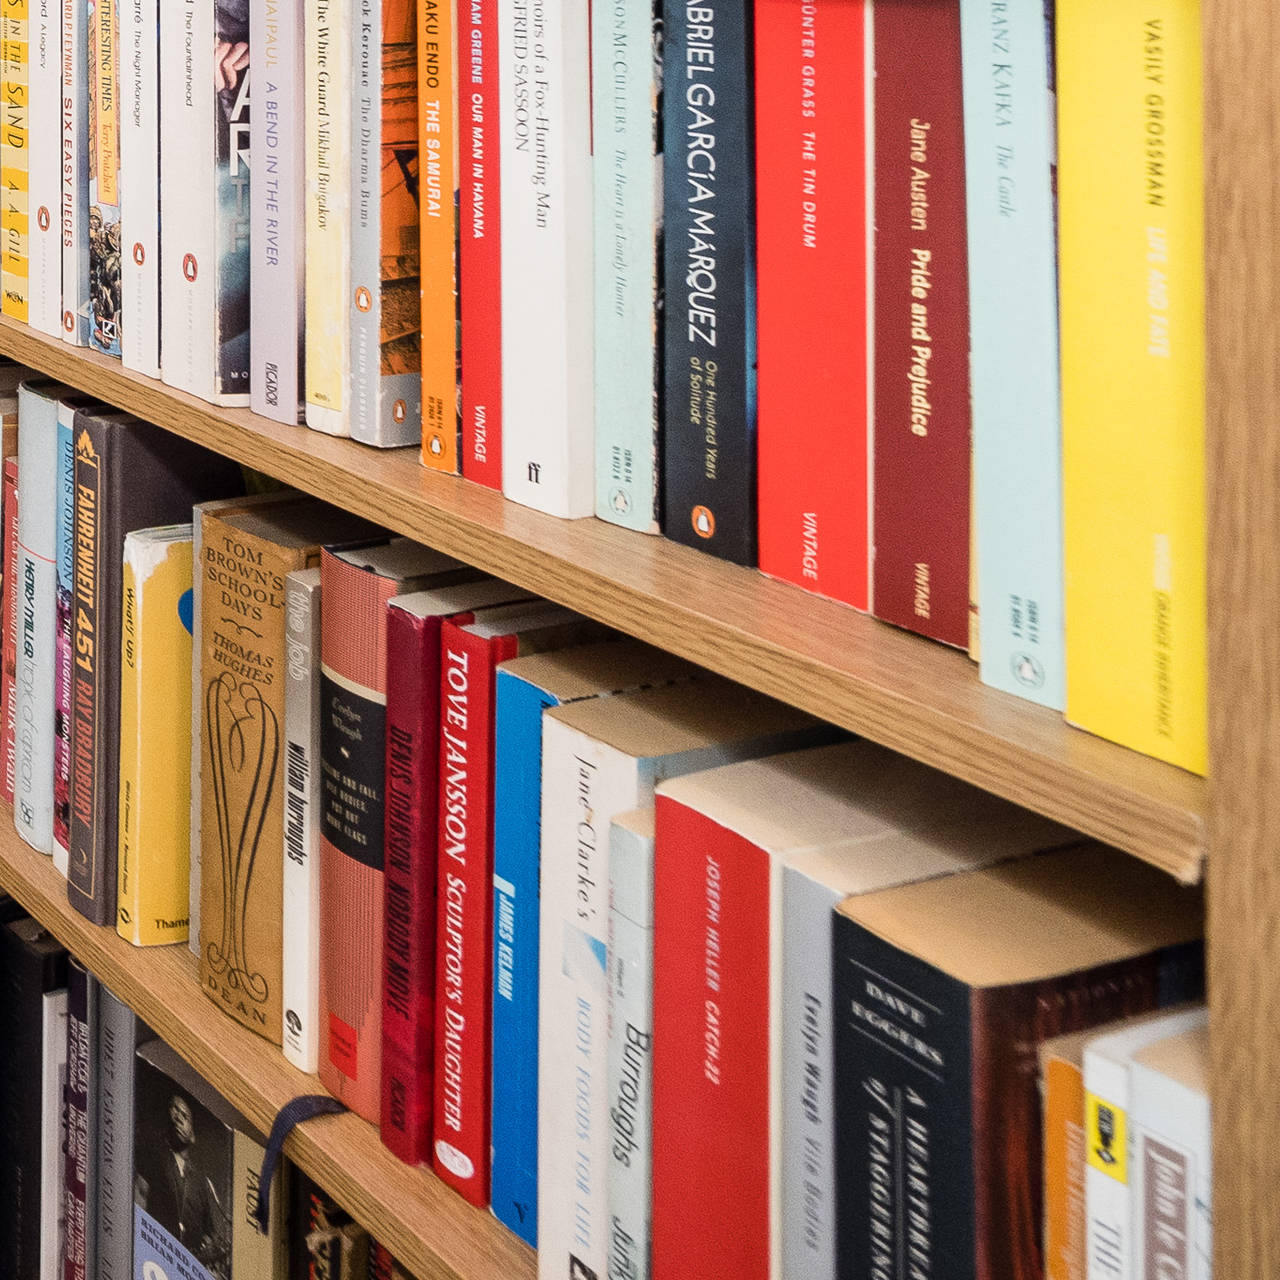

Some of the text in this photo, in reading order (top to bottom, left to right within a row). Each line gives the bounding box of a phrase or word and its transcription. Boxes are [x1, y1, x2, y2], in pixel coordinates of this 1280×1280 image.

[10, 20, 21, 36] IN
[64, 22, 73, 33] P.
[134, 30, 142, 46] The
[317, 27, 330, 68] White
[534, 41, 547, 61] of
[10, 44, 21, 72] THE
[64, 34, 73, 86] FEYNMAN
[133, 50, 142, 77] Night
[185, 31, 193, 107] Fountainhead
[361, 22, 372, 88] Kerouac
[426, 41, 439, 89] ENDO
[470, 29, 483, 84] GREENE
[536, 65, 546, 75] a
[101, 76, 112, 112] TIMES
[132, 79, 142, 128] Manager
[266, 82, 278, 94] A
[317, 71, 330, 117] Guard
[361, 97, 371, 122] The
[471, 92, 483, 122] OUR
[514, 64, 529, 152] SASSOON
[802, 64, 816, 118] GRASS
[991, 63, 1012, 128] KAFKA
[7, 82, 24, 149] SAND
[64, 97, 73, 131] SIX
[266, 100, 278, 149] BEND
[426, 100, 440, 132] THE
[532, 80, 551, 187] Fox-Hunting
[1144, 19, 1165, 208] VASILY GROSSMAN
[64, 138, 73, 186] EASY
[266, 154, 278, 175] IN
[317, 118, 330, 171] Mikhail
[360, 128, 371, 185] Dharma
[471, 123, 484, 159] MAN
[686, 85, 715, 204] GARCÍA
[802, 131, 816, 161] THE
[996, 145, 1016, 171] The
[8, 180, 21, 195] A.
[426, 138, 441, 218] SAMURAI
[472, 164, 484, 178] IN
[802, 167, 816, 195] TIN
[8, 204, 21, 218] A.
[266, 179, 278, 212] THE
[317, 173, 329, 231] Bulgakov
[473, 182, 485, 239] HAVANA
[535, 193, 548, 230] Man
[998, 175, 1017, 219] Castle
[64, 193, 73, 248] PIECES
[265, 218, 279, 267] RIVER
[802, 201, 817, 249] DRUM
[8, 228, 21, 262] GILL
[686, 208, 717, 347] MÁRQUEZ
[910, 118, 932, 437] Jane Austen Pride and Prejudice
[265, 361, 278, 408] PICADOR
[689, 356, 702, 425] of Solitude
[474, 405, 487, 464] VINTAGE
[705, 361, 719, 480] One Hundred Years
[527, 461, 542, 484] ff
[206, 547, 284, 591] BROWN'S
[223, 536, 263, 567] TOM
[802, 511, 818, 582] VINTAGE
[23, 558, 36, 660] HENRY MILLER
[221, 590, 263, 621] DAYS
[913, 562, 931, 619] VINTAGE
[74, 483, 96, 828] FAHRENHEIT 451 RAY BRADBURY
[212, 631, 274, 669] THOMAS
[212, 650, 274, 686] HUGHES
[575, 753, 599, 921] Jane Clarke's
[443, 649, 468, 1133] TOVE JANSSON SCULPTOR'S DAUGHTER
[704, 855, 721, 1086] JOSEPH HELLER CATCH-22
[865, 980, 927, 1028] DAVE
[851, 1000, 945, 1066] EGGERS
[609, 1021, 650, 1168] Burroughs
